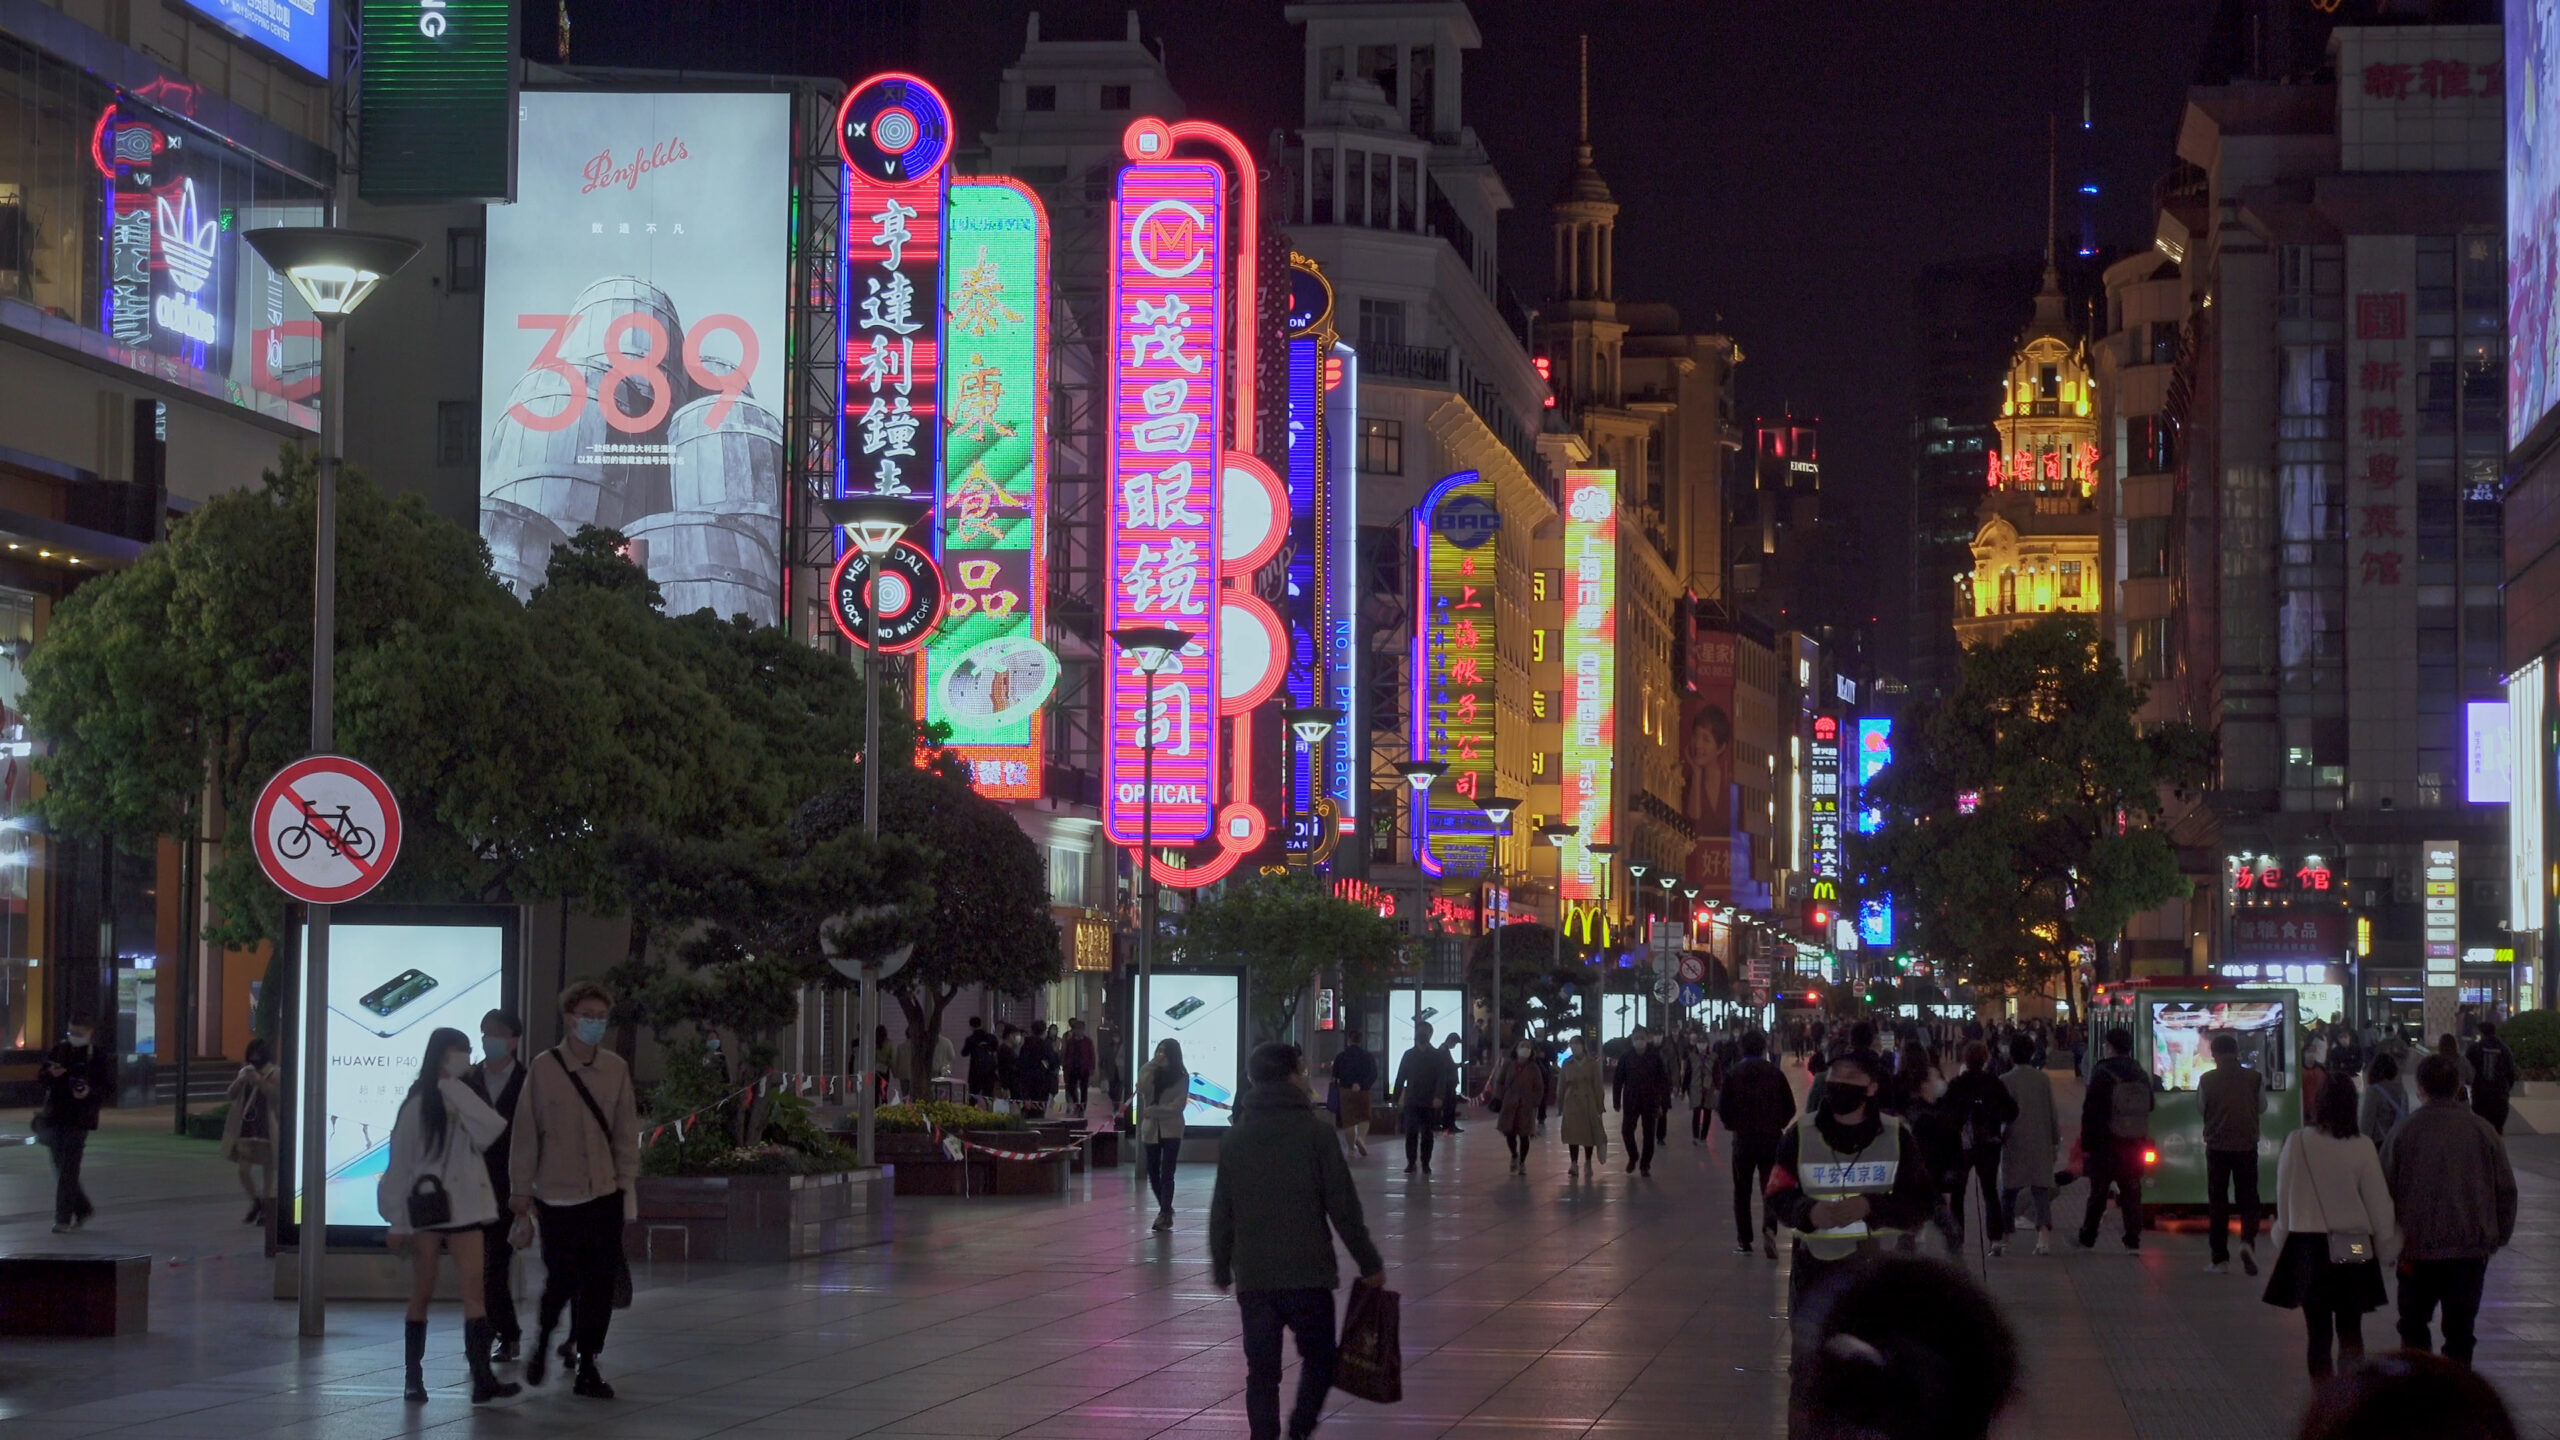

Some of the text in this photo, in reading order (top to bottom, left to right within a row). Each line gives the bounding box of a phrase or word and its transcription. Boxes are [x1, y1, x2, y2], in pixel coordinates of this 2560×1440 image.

[270, 22, 291, 42] CENTER
[581, 136, 689, 195] Penfolds
[156, 294, 216, 345] adidas
[507, 313, 760, 434] 389
[946, 245, 1025, 618] 泰康食品
[842, 588, 863, 627] CLOCK
[896, 596, 932, 636] WATCHE
[1331, 619, 1351, 800] No.1 Pharmacy
[1119, 783, 1202, 804] OPTICAL
[1579, 760, 1597, 795] First
[2234, 865, 2331, 890] 汤包馆
[331, 1055, 418, 1068] HUAWEI P40
[1812, 1164, 1888, 1184] 平安南京路
